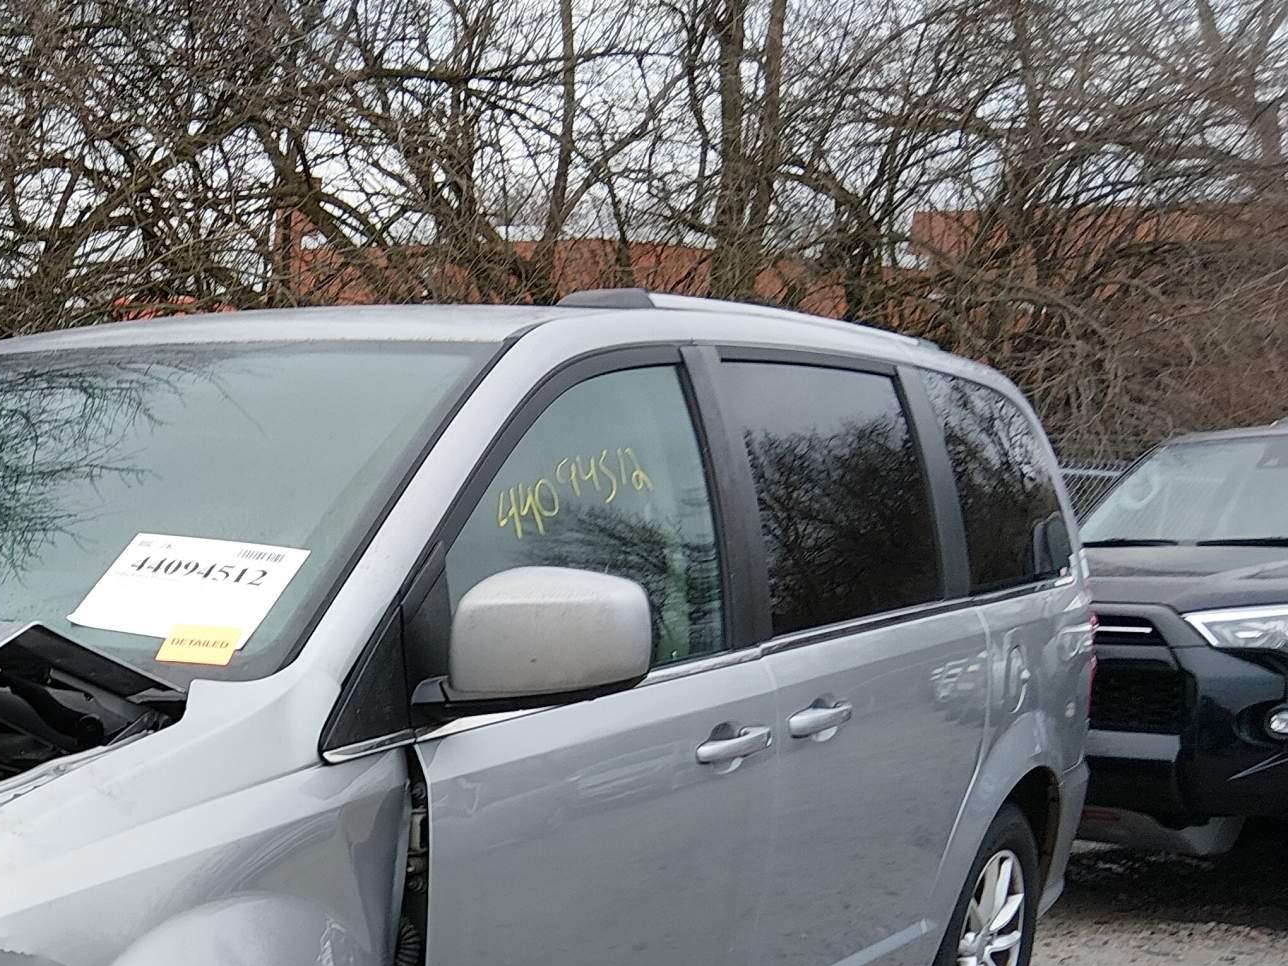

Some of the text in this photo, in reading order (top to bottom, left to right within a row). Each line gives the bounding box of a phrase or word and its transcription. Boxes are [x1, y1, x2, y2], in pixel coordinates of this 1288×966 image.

[498, 448, 653, 539] 44094512
[131, 556, 268, 587] 44094512
[170, 637, 230, 649] DETAILED
